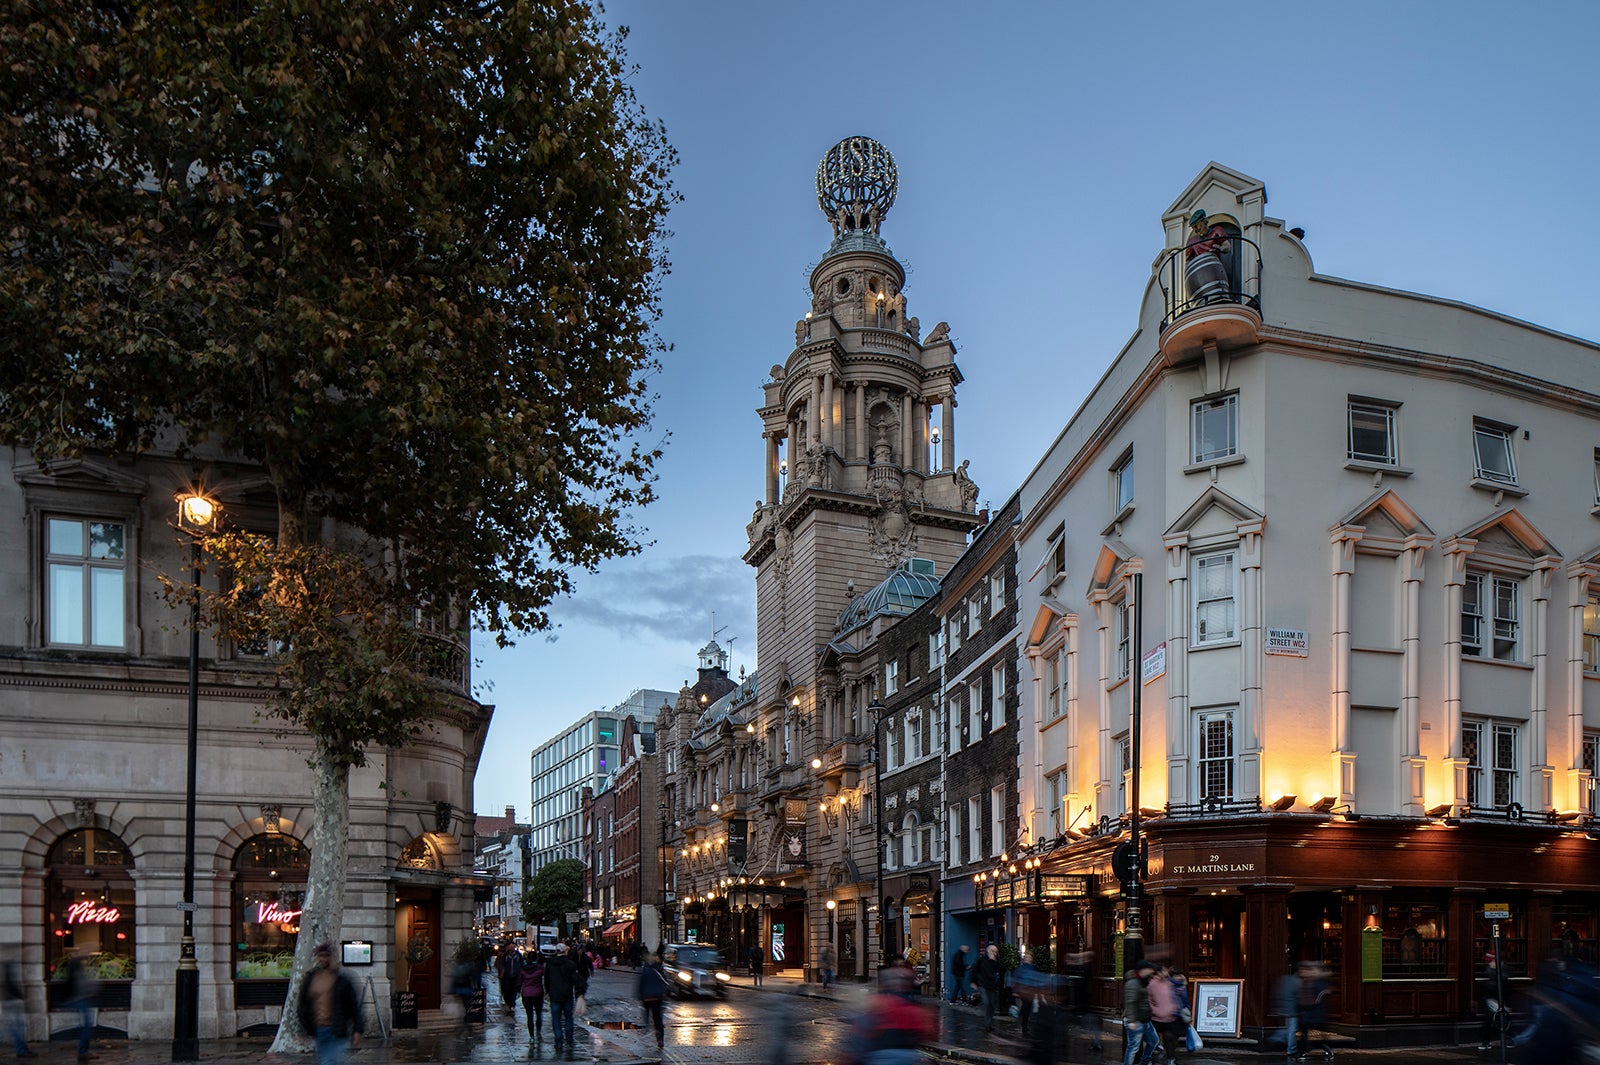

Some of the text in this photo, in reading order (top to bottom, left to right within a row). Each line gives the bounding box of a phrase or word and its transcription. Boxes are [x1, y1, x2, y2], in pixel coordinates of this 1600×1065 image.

[1269, 630, 1304, 640] WILLIAM IV
[1269, 638, 1306, 649] STREET WC2
[1209, 854, 1219, 862] 29
[1173, 863, 1255, 874] ST. MARTINS LANE
[1098, 869, 1114, 885] THE
[68, 900, 120, 924] Pizza
[258, 901, 302, 923] Vino
